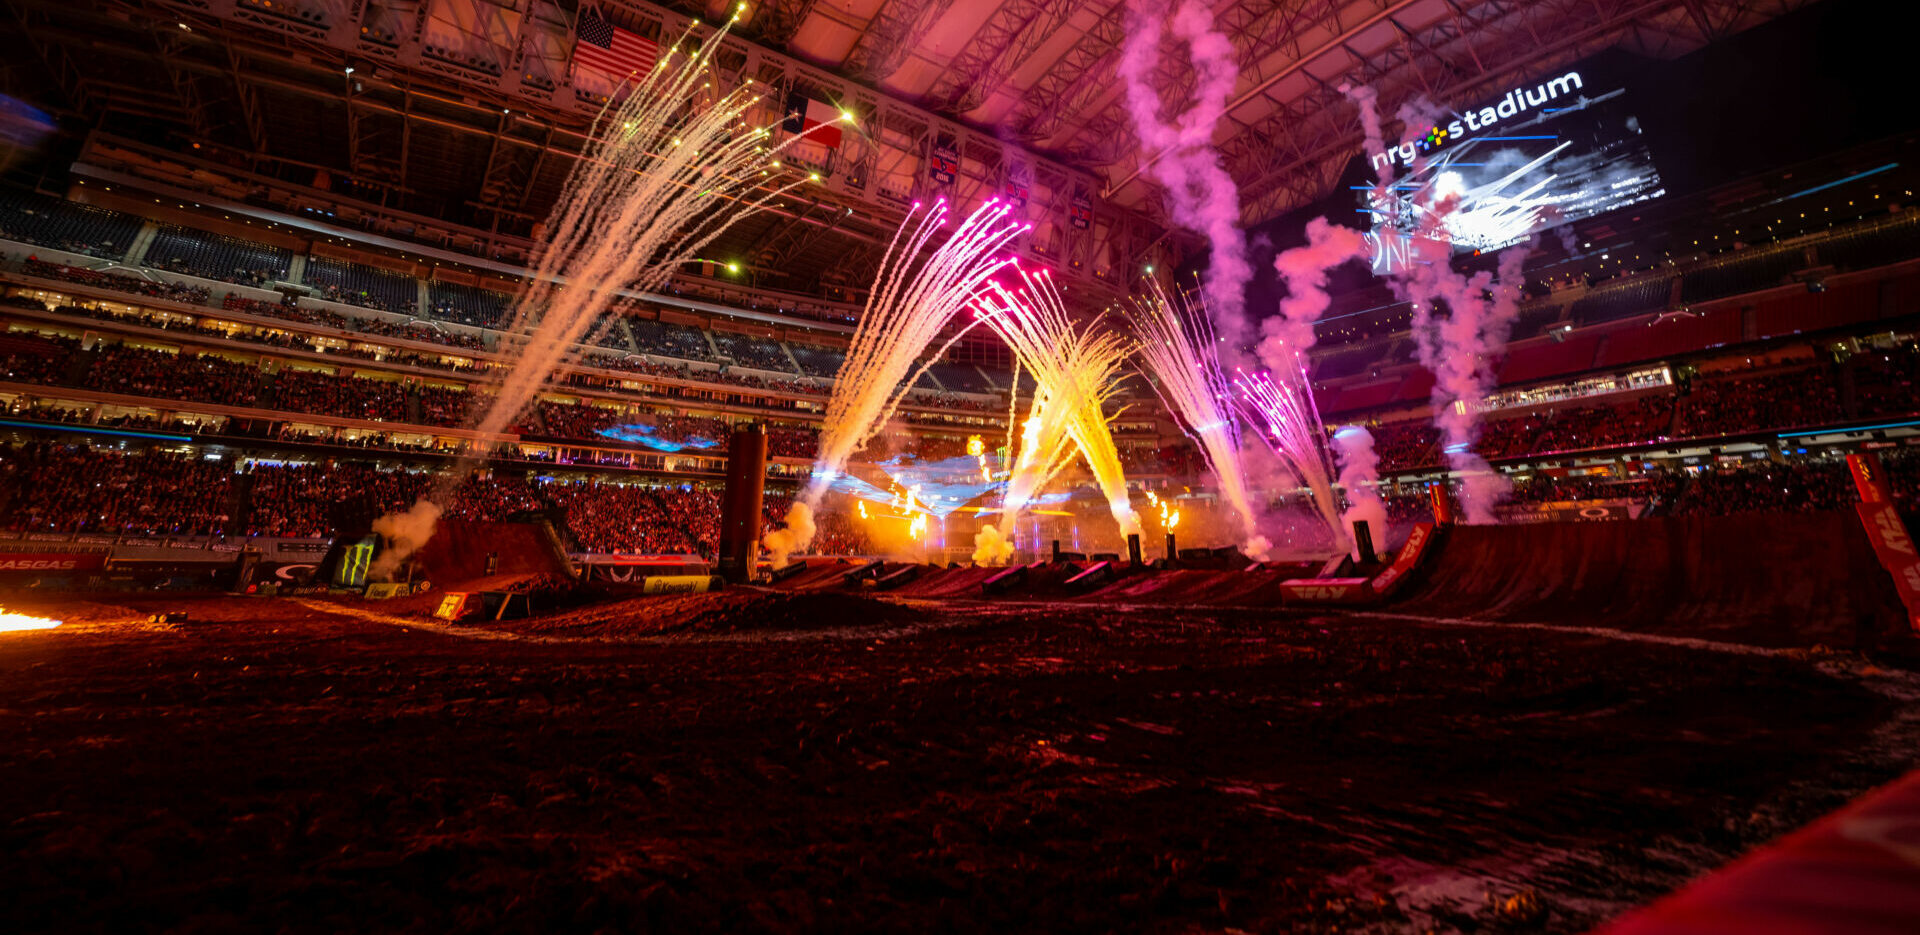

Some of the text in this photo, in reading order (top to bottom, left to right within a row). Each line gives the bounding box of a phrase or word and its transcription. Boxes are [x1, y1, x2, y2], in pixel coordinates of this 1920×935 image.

[1371, 71, 1584, 171] nrg stadium
[0, 560, 77, 570] ASGAS
[1289, 586, 1348, 600] FLY
